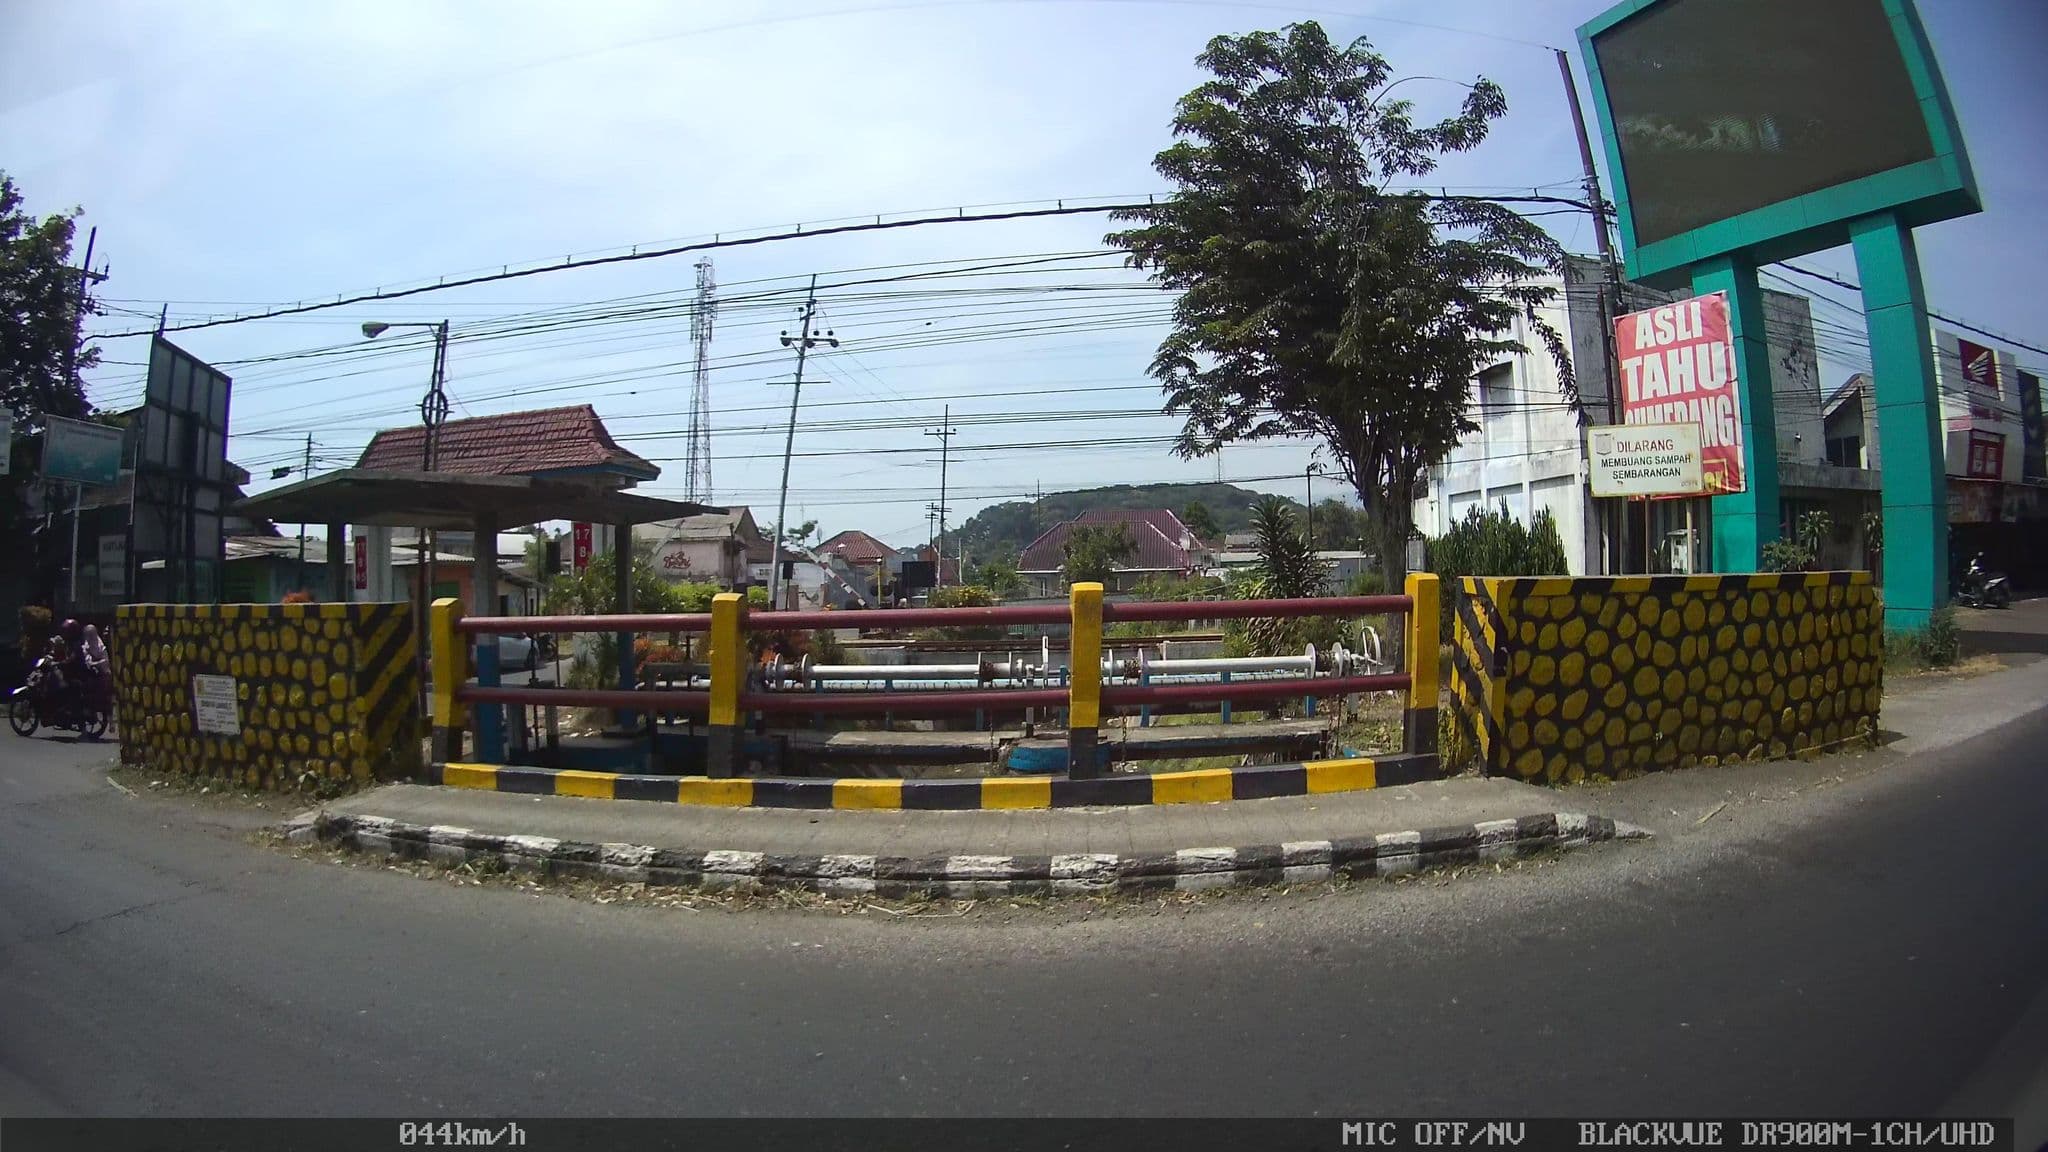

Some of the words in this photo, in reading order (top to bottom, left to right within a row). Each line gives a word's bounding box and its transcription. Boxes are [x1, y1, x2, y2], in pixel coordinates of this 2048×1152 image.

[1635, 302, 1703, 350] ASLI
[1621, 341, 1728, 402] TAHU
[1617, 439, 1674, 453] DILARANG
[1601, 456, 1653, 468] MEMBUANG
[1654, 454, 1691, 465] SAMPAH
[1612, 467, 1681, 480] SEMBARANGAN
